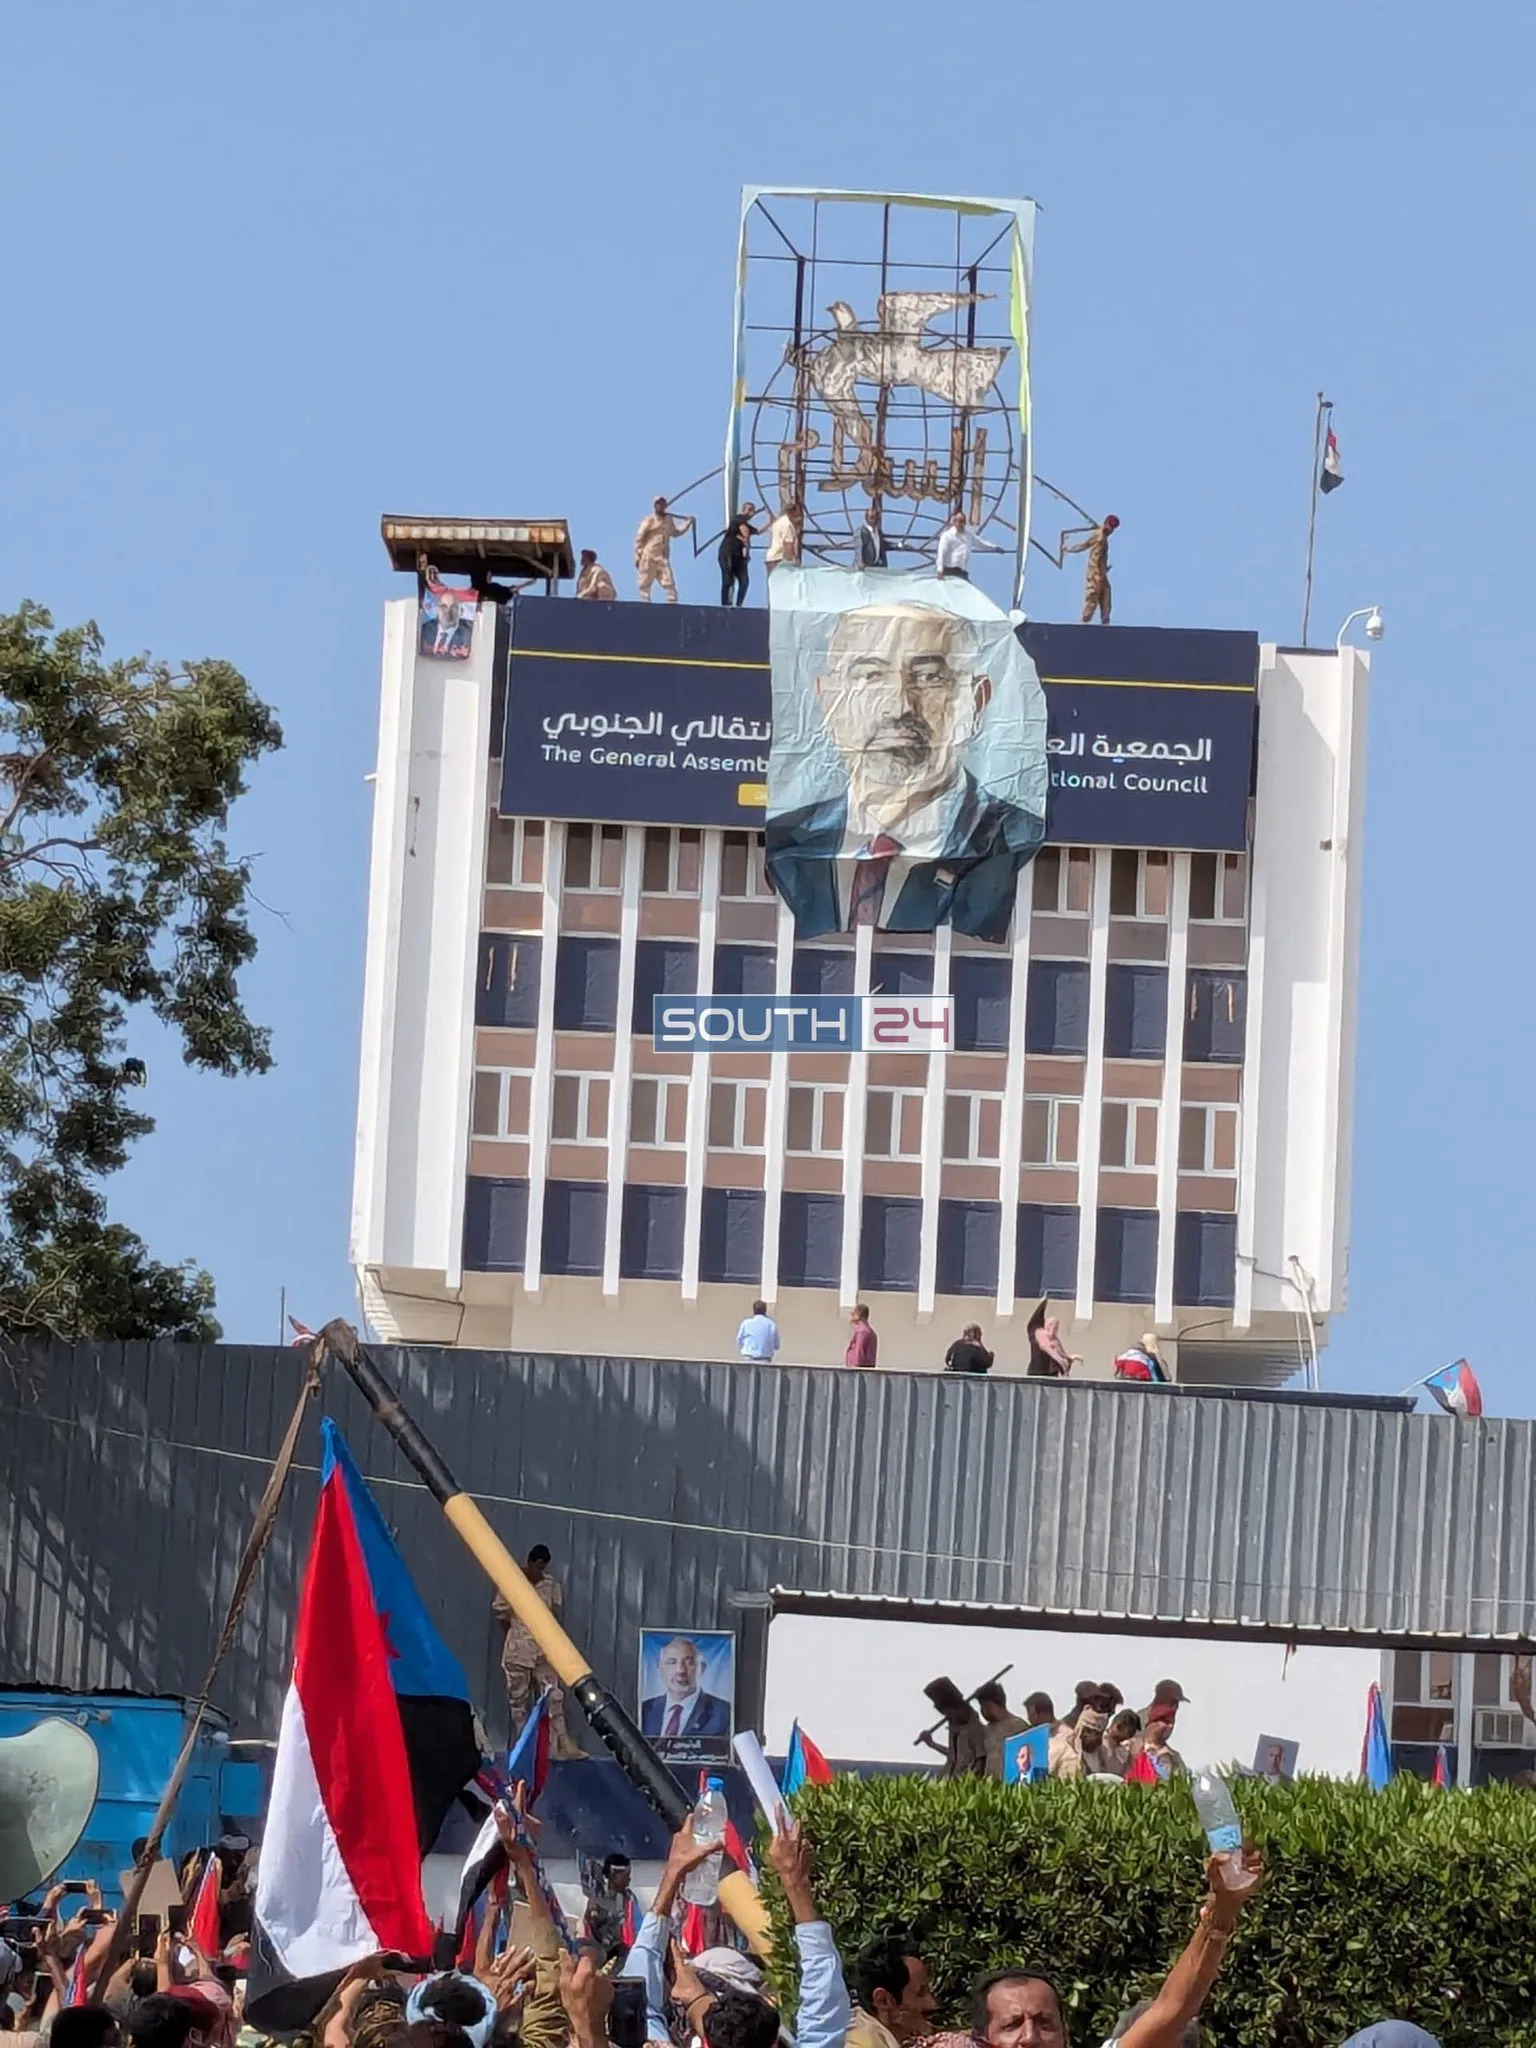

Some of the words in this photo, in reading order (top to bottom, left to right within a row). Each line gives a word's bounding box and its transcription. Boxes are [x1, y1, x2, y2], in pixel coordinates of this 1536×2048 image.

[542, 710, 663, 740] الجنوبي
[671, 714, 772, 747] نتقالي
[1046, 732, 1085, 756] الع
[1092, 733, 1213, 766] الجمعية
[541, 744, 582, 763] The
[589, 747, 677, 769] General
[681, 752, 769, 773] Assemb
[1051, 770, 1118, 790] tional
[1123, 773, 1209, 794] Council
